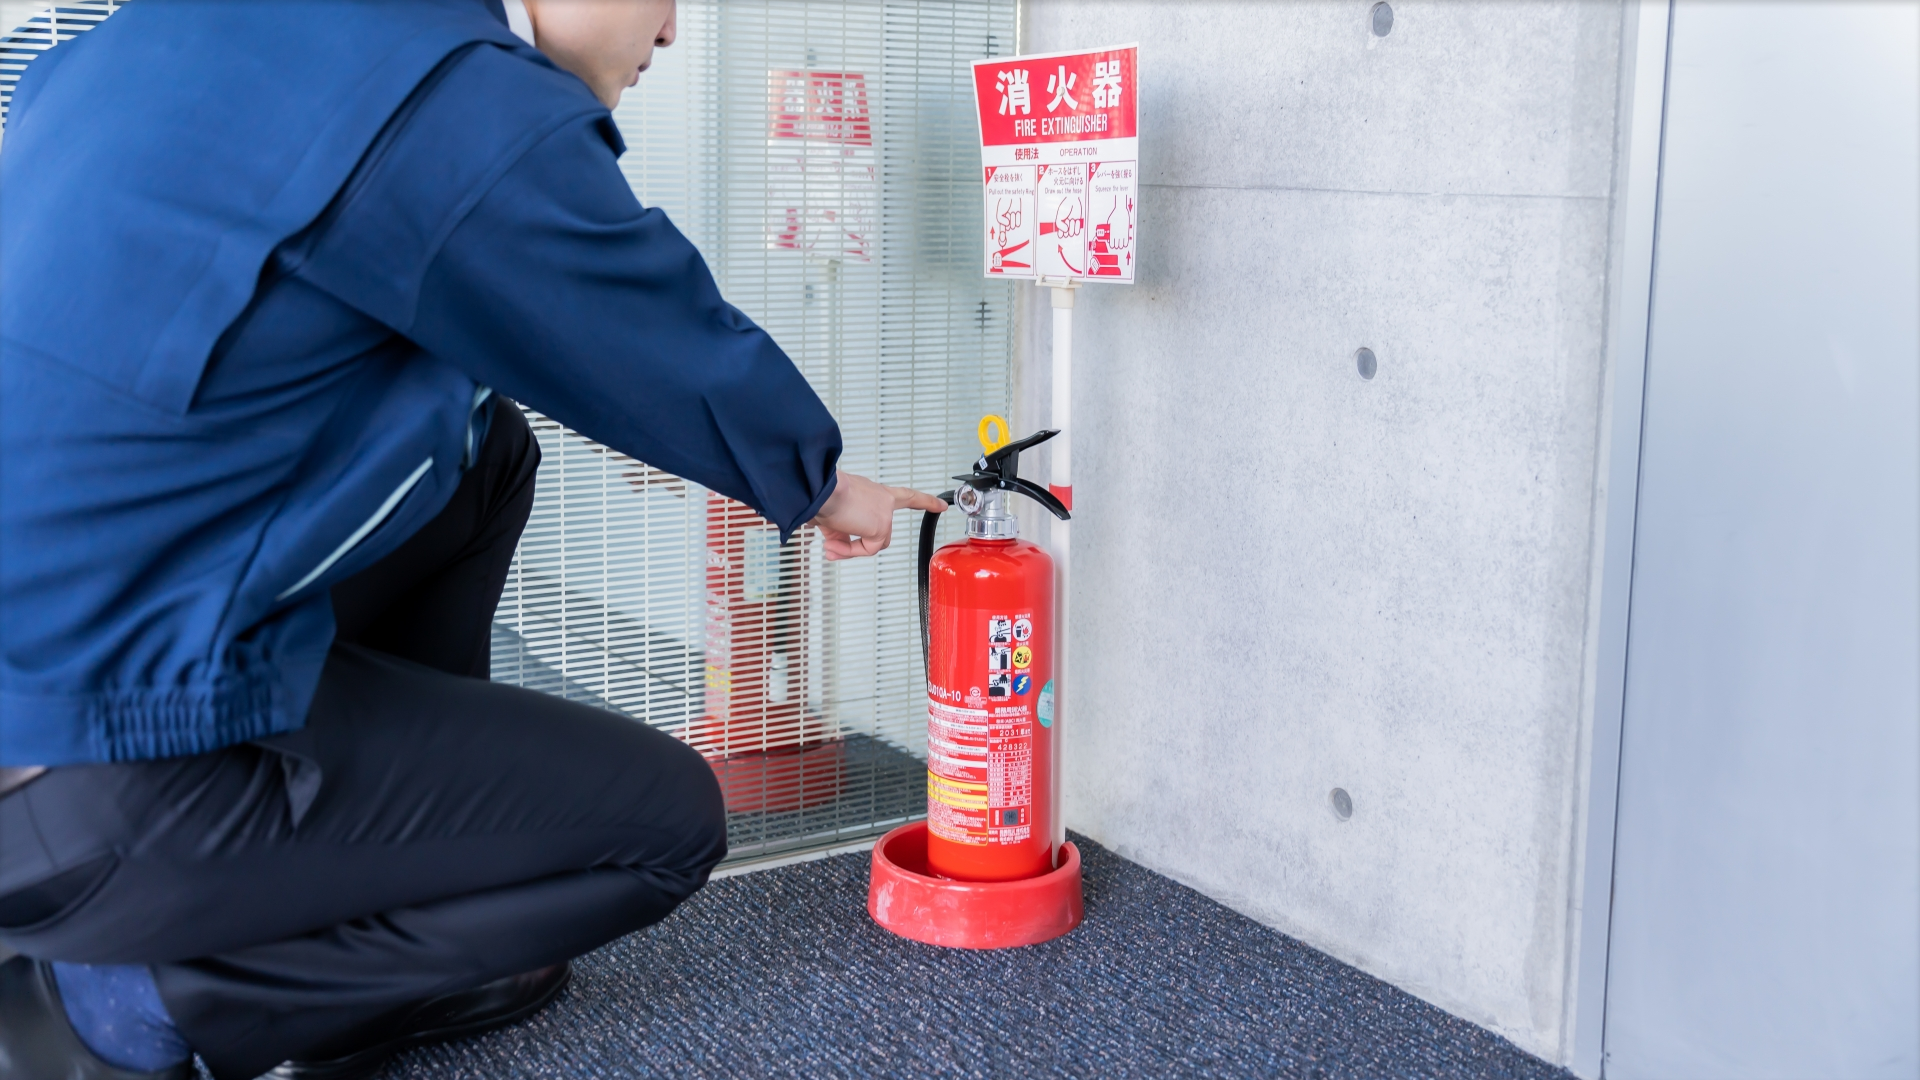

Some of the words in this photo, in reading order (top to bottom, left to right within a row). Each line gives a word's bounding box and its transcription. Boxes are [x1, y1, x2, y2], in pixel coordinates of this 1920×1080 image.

[995, 60, 1122, 116] 消火器
[1015, 119, 1037, 137] FIRE
[1041, 113, 1108, 135] EXTINGUISHER
[1015, 147, 1039, 161] 使用法
[1060, 147, 1098, 157] OPERATION
[1038, 165, 1045, 175] 2
[1048, 166, 1082, 176] ホースをはずし
[1090, 163, 1096, 173] 3
[997, 742, 1028, 751] 428322
